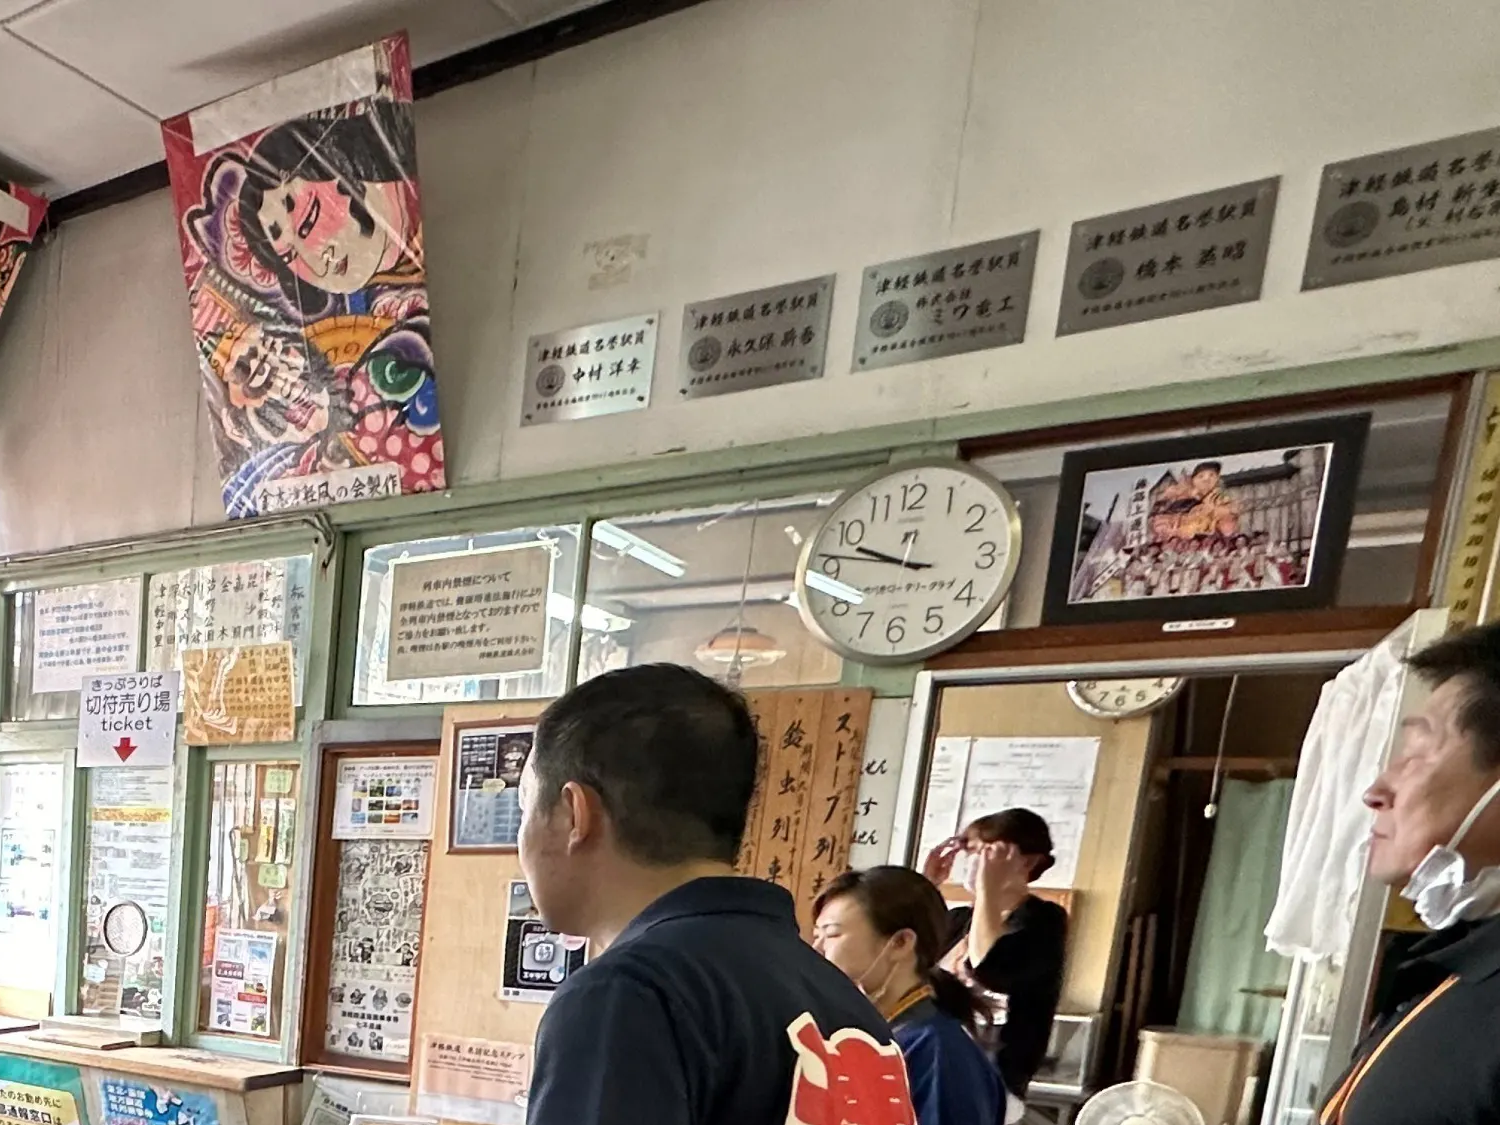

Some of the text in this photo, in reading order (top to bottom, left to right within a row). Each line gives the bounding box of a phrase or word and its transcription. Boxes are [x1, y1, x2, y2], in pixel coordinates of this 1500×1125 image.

[870, 494, 891, 522] 11
[901, 483, 927, 512] 12
[946, 486, 955, 515] 1
[838, 519, 865, 546] 10
[964, 504, 987, 533] 2
[822, 555, 841, 580] 9
[975, 541, 996, 570] 3
[954, 579, 976, 607] 4
[857, 611, 874, 639] 7
[885, 615, 906, 644] 6
[923, 605, 944, 634] 5
[86, 691, 170, 715] 切符売り場
[1099, 691, 1110, 702] 7
[1115, 695, 1125, 707] 6
[1135, 690, 1146, 702] 5
[101, 716, 153, 731] ticket
